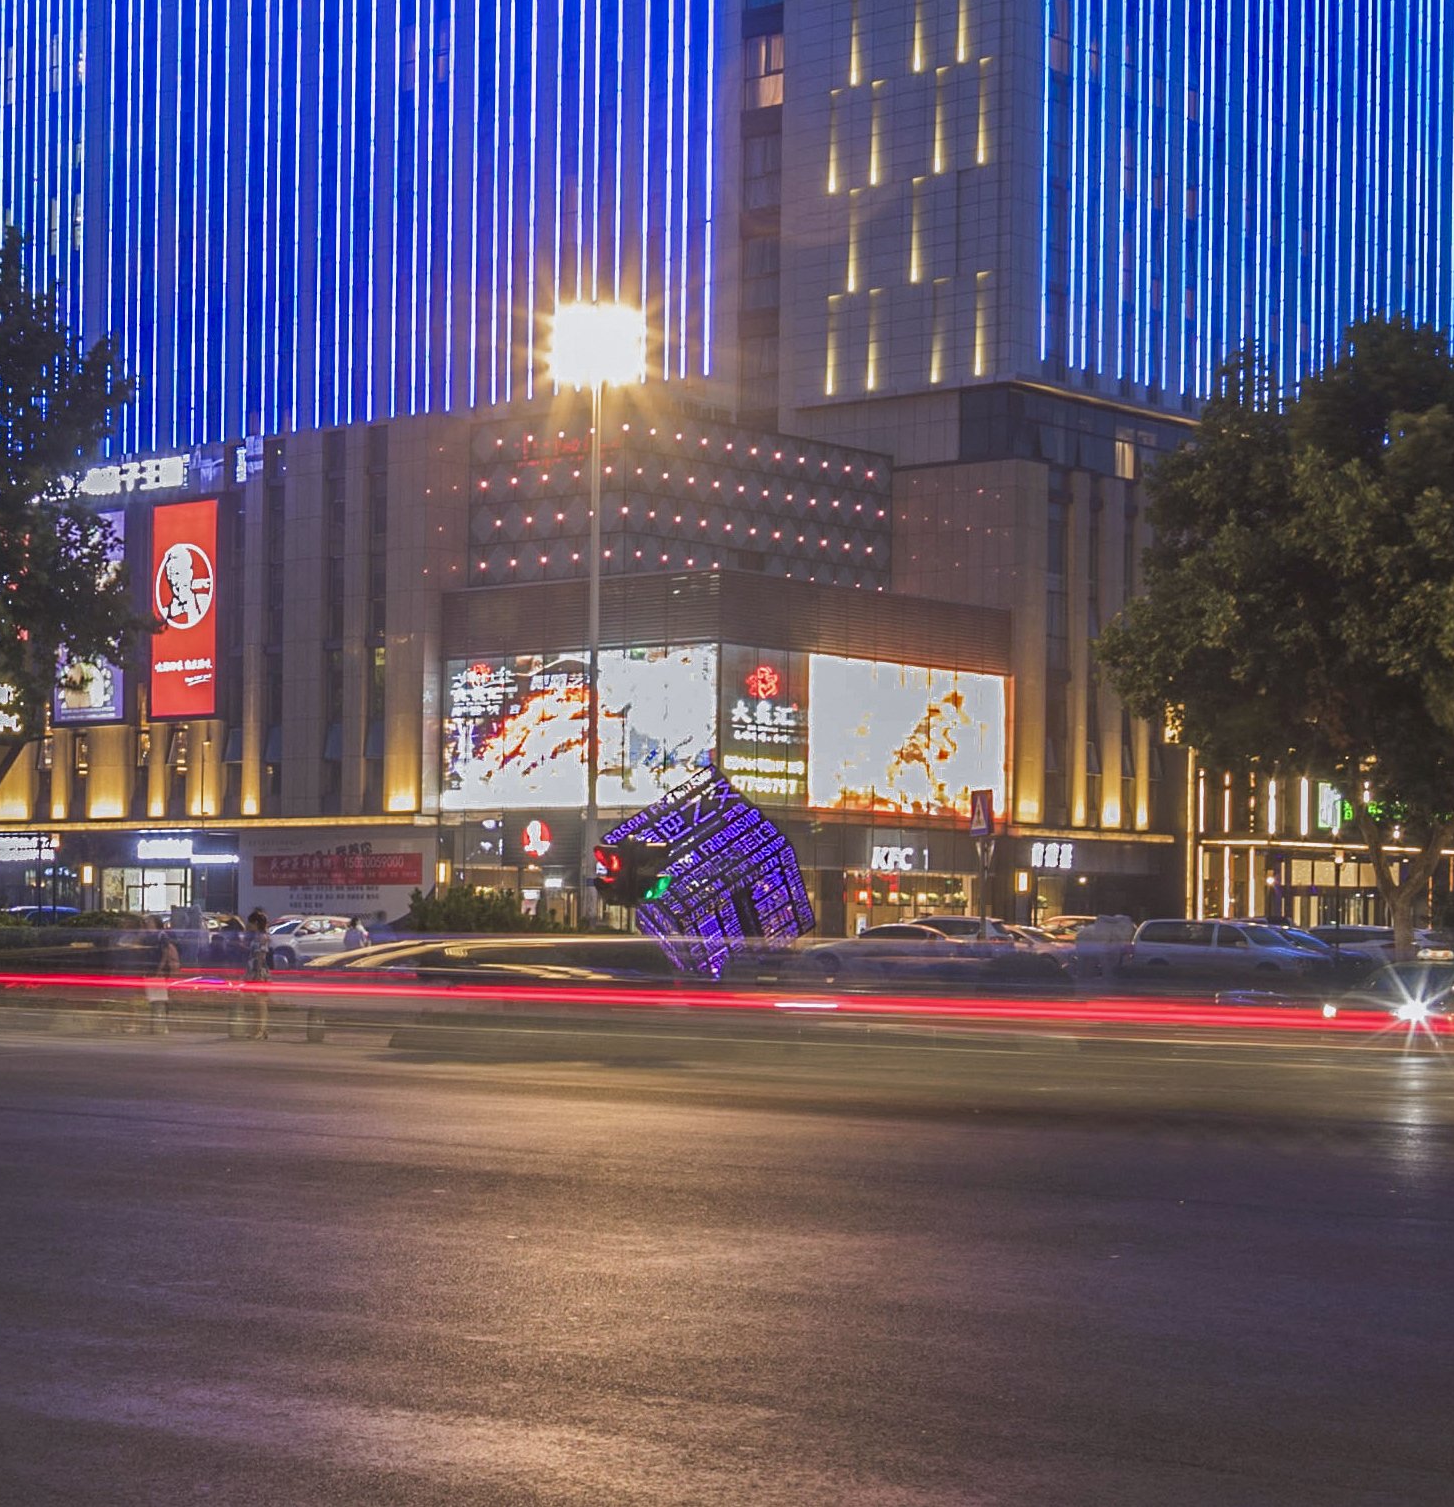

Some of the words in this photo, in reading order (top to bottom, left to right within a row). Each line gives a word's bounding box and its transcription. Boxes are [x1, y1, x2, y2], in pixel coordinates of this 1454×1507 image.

[603, 812, 650, 845] BOSOM
[697, 808, 762, 857] FRIENDSHIP
[871, 845, 914, 871] KFC
